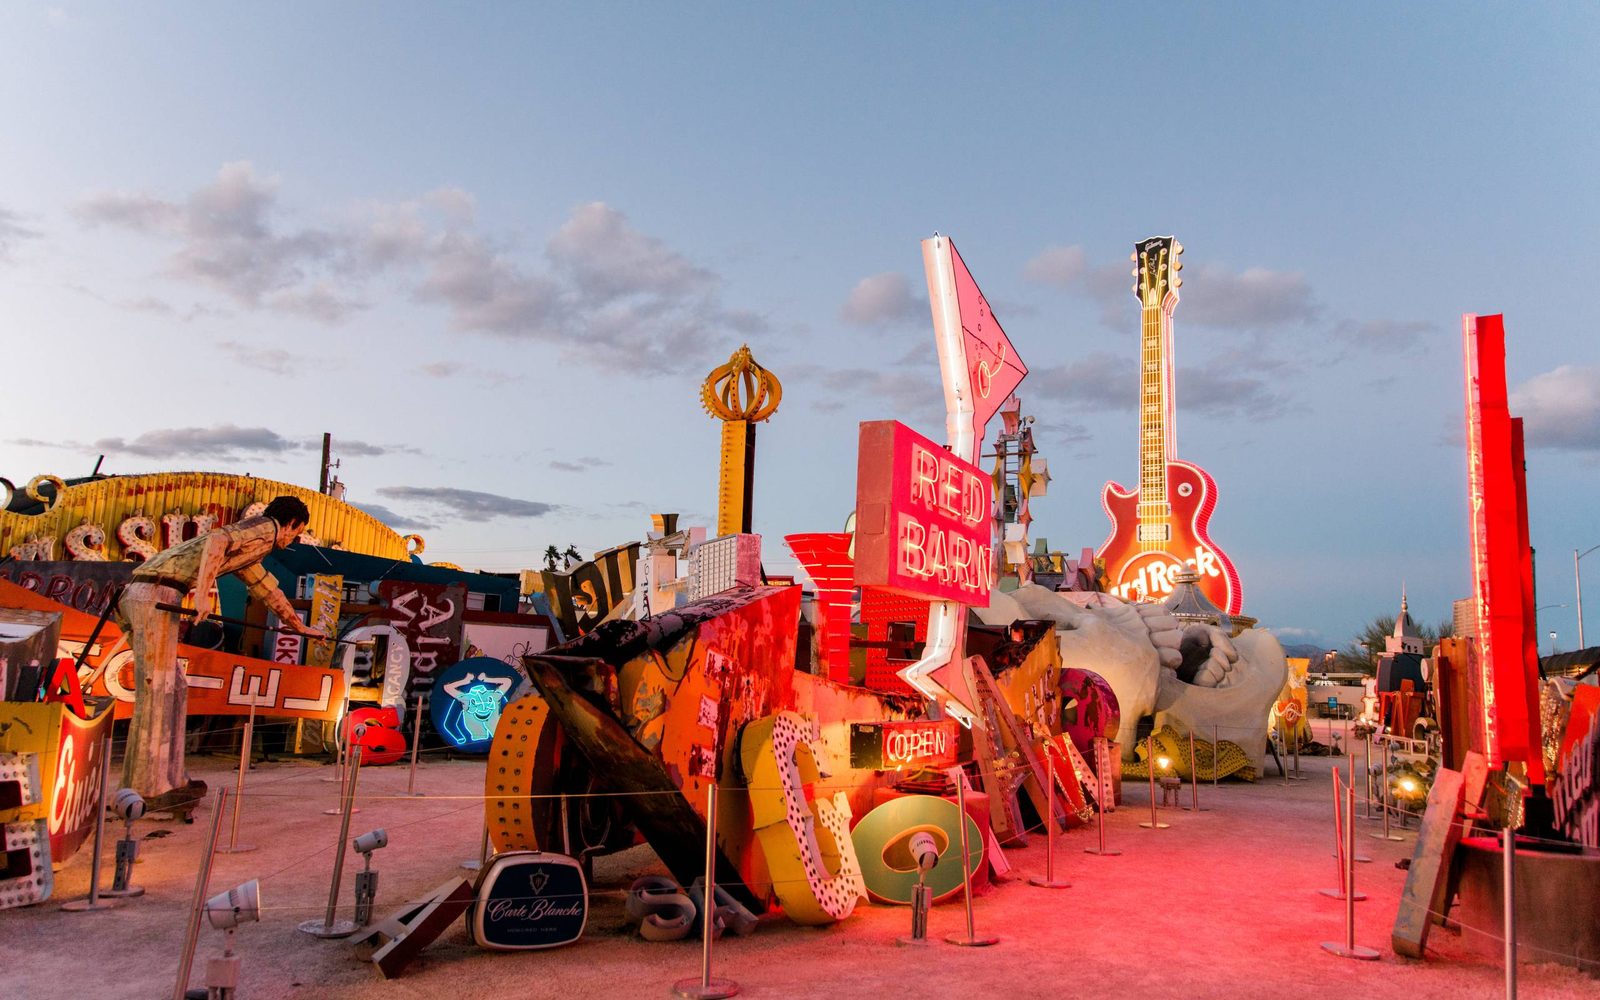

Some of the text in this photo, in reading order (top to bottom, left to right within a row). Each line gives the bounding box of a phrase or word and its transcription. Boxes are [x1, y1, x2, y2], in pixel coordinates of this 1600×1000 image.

[910, 441, 985, 528] RED
[897, 511, 992, 597] BARN
[887, 730, 947, 762] OPEN
[487, 899, 583, 921] Carte Blanche
